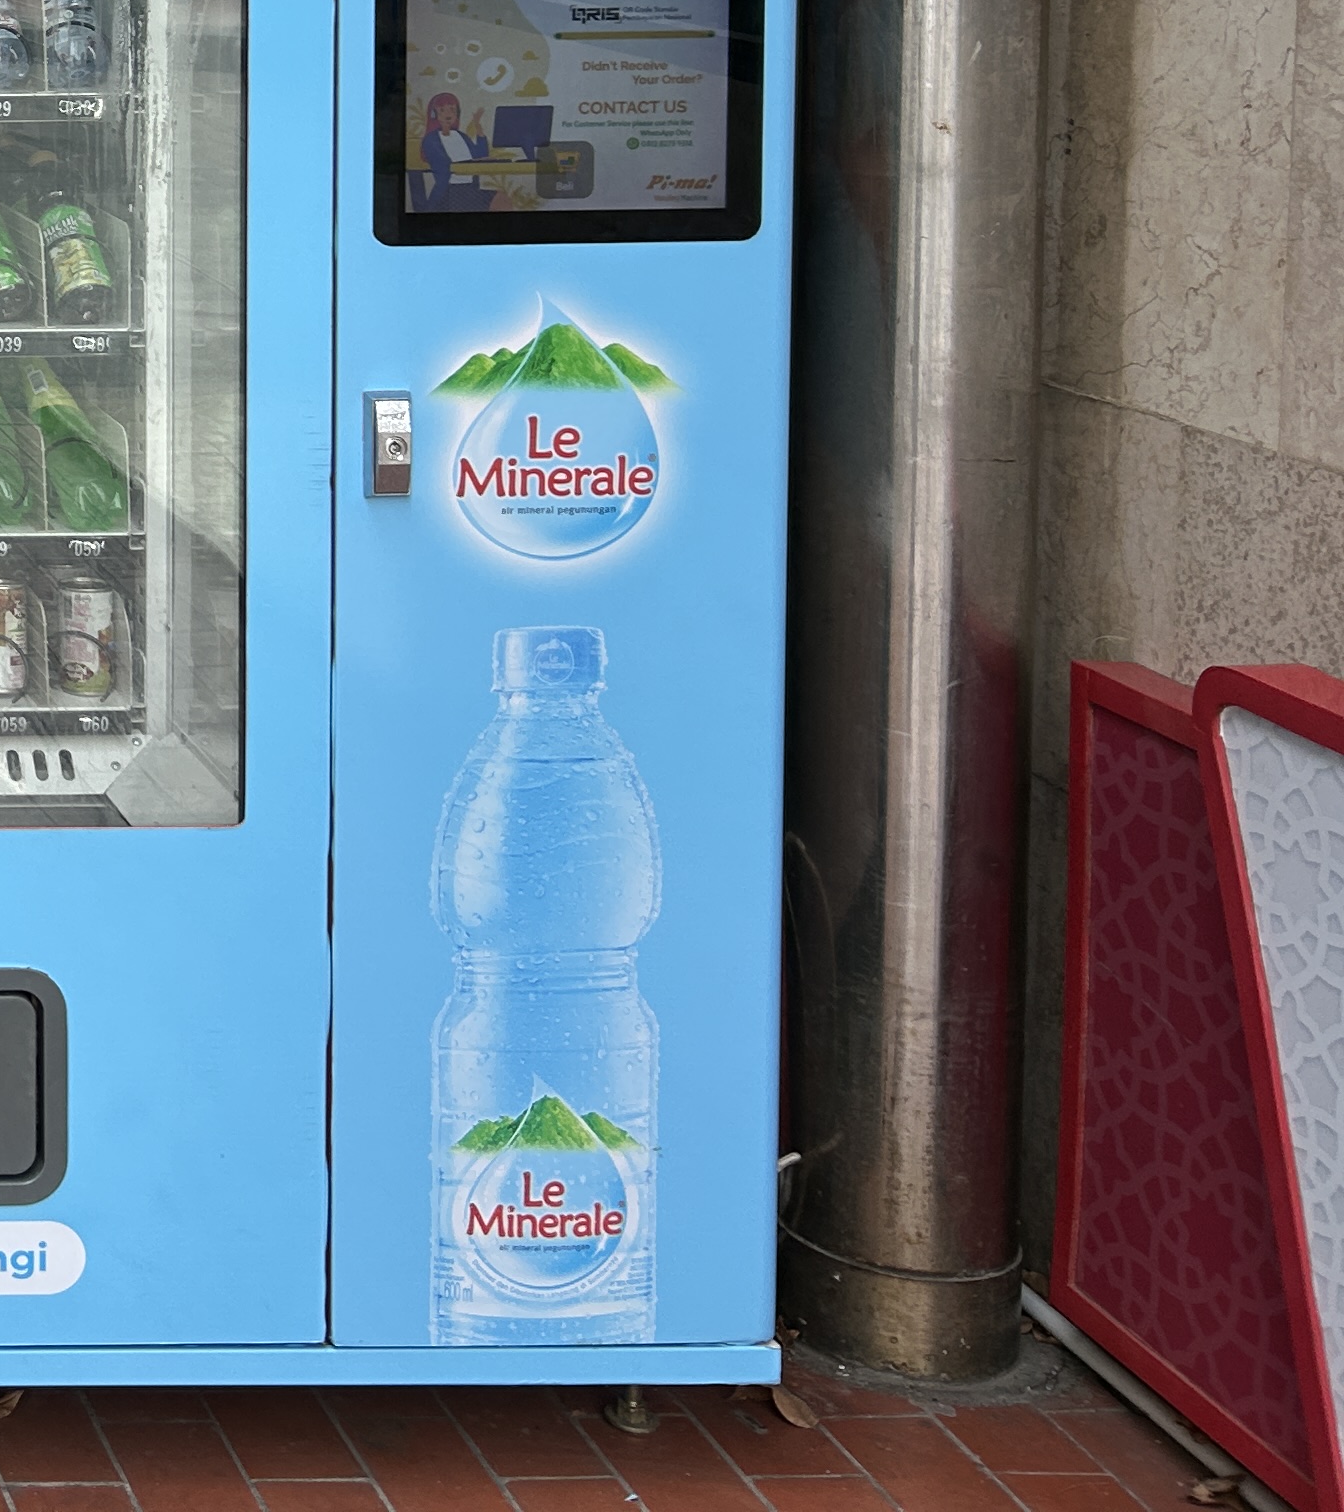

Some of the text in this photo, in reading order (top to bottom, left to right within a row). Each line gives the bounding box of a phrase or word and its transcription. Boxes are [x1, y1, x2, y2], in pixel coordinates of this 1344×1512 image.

[582, 61, 669, 72] Didn't Receive
[632, 73, 704, 86] Your Order?
[578, 100, 688, 115] CONTACT US
[528, 415, 581, 460] Le
[455, 454, 655, 499] Minerale
[501, 505, 617, 517] air mineral pegunungan
[0, 716, 27, 733] 059
[522, 1171, 566, 1208] Le
[466, 1201, 624, 1239] Minerale
